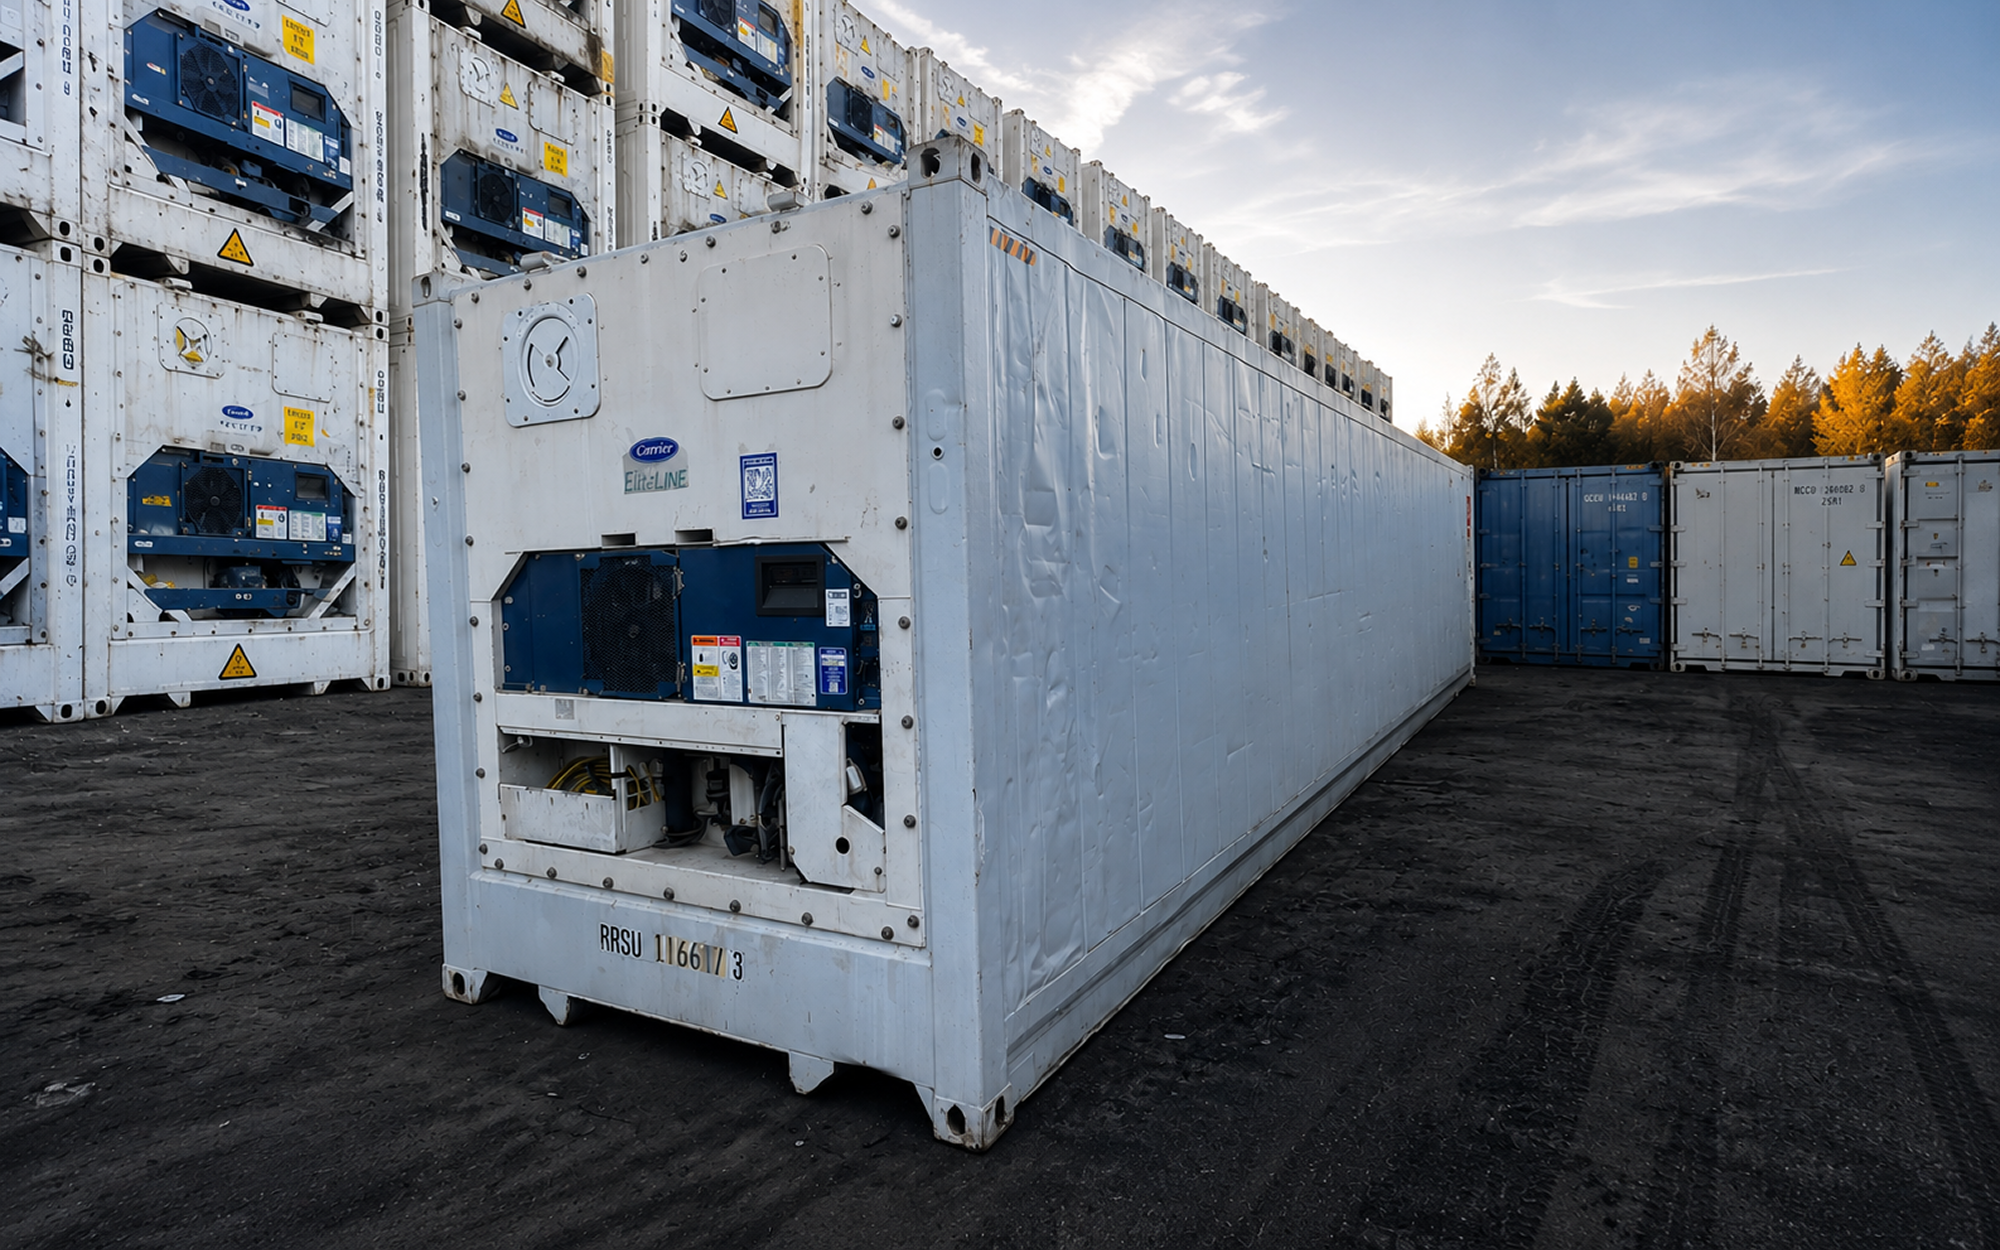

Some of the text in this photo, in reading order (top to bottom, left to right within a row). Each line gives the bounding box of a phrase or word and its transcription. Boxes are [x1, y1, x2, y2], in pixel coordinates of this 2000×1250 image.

[636, 442, 674, 457] Carrier
[600, 923, 642, 958] RRSU
[733, 951, 743, 981] 3
